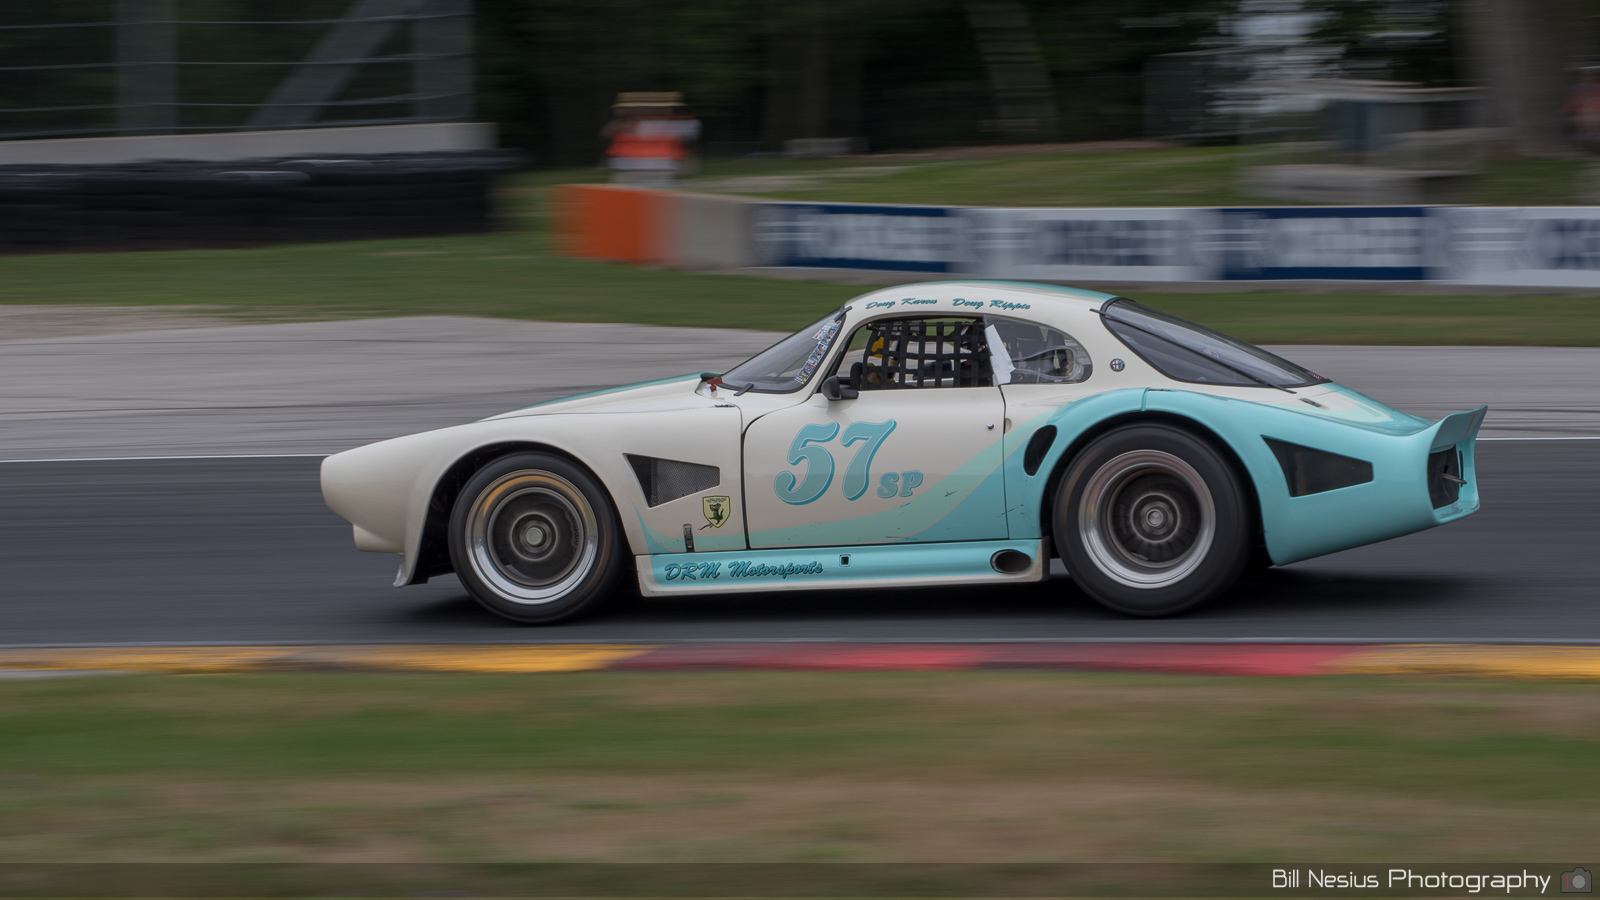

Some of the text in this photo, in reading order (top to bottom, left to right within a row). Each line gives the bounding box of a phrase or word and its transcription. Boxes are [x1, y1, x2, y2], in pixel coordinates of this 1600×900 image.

[865, 301, 896, 310] Doug
[952, 298, 984, 309] Doug
[774, 418, 898, 506] 57
[876, 470, 924, 499] SP
[664, 560, 824, 581] DRM Motorsports
